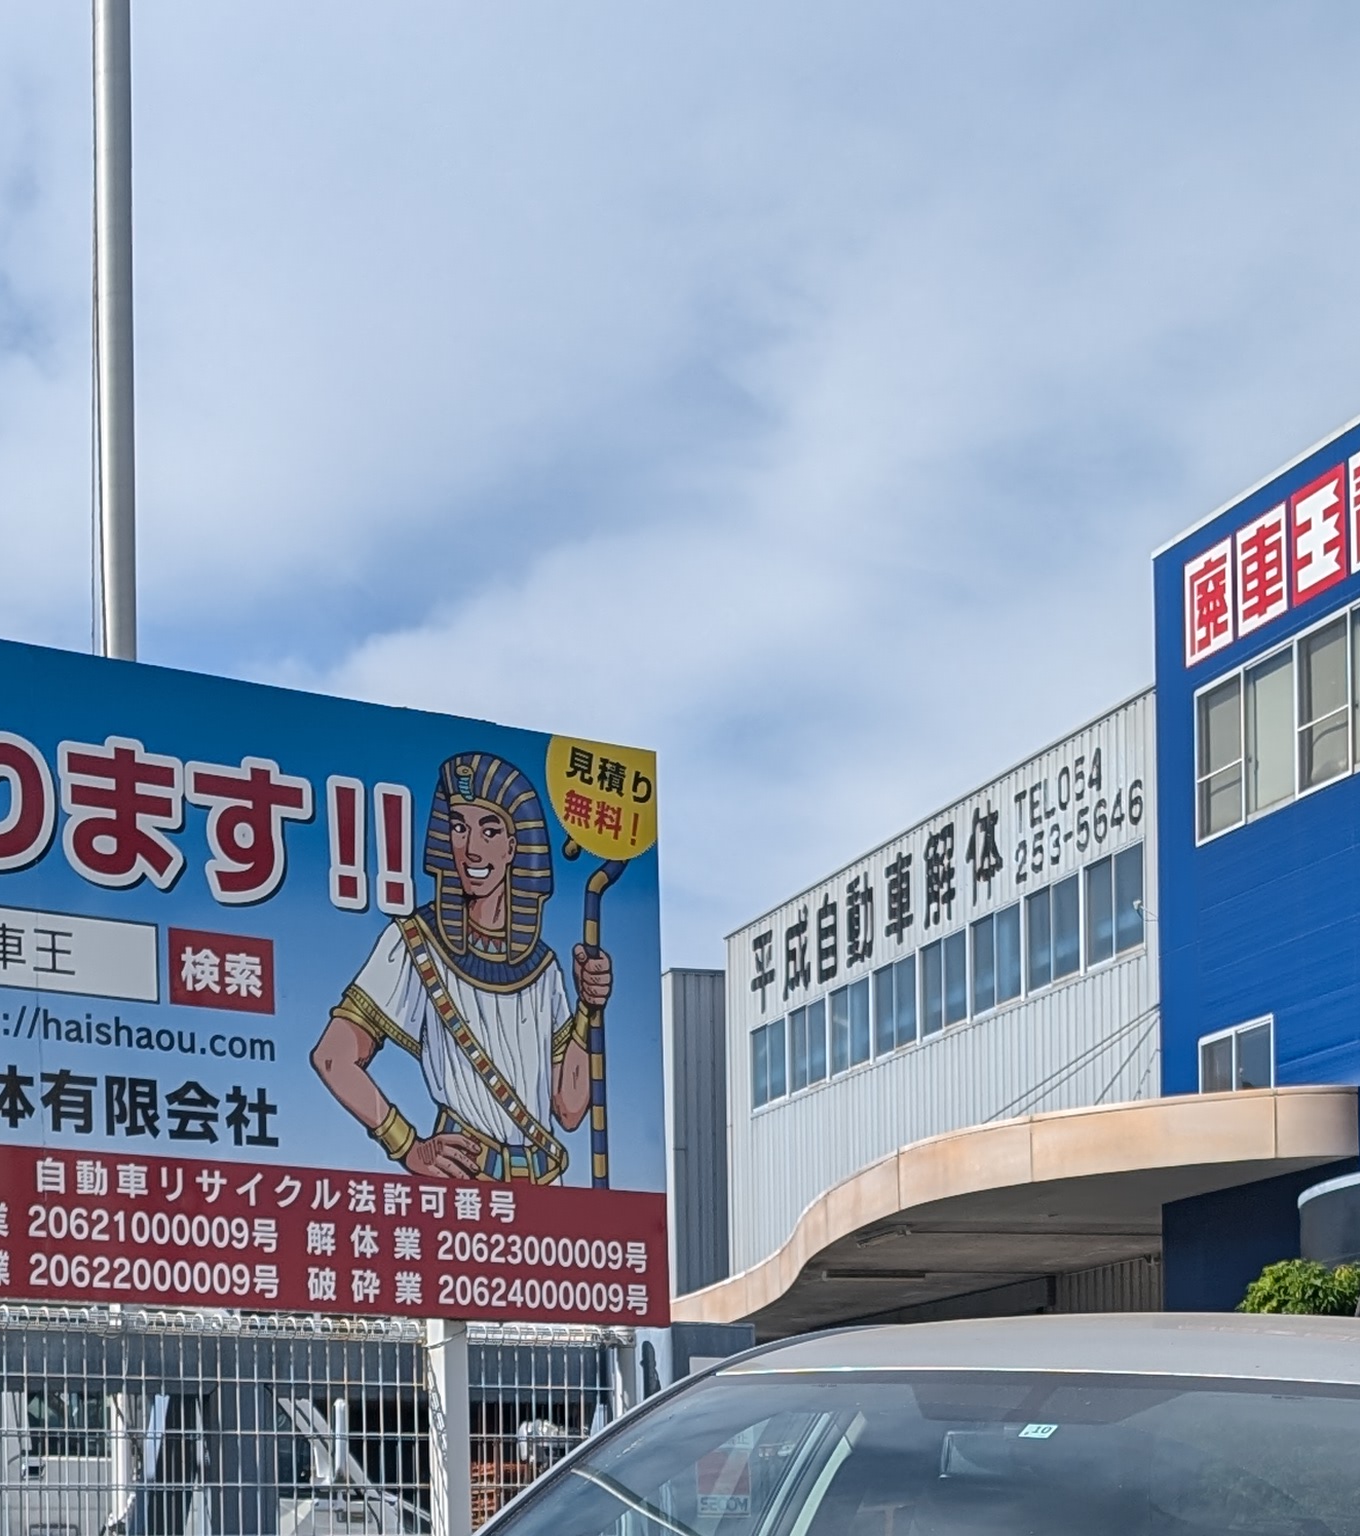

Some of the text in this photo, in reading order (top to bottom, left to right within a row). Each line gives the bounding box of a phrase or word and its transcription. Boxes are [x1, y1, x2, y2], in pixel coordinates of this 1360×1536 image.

[566, 746, 652, 803] 見積り
[563, 789, 639, 846] 無料！
[1015, 778, 1143, 885] 253-5646
[751, 800, 1003, 1013] 平成自動車解体
[180, 946, 263, 999] 検索
[36, 1157, 517, 1224] 自動車リサイクル法許可番号
[28, 1205, 278, 1254] 20621000009号
[306, 1221, 422, 1261] 解体業
[437, 1230, 648, 1274] 20623000009号
[29, 1253, 279, 1300] 20622000009号
[307, 1267, 423, 1305] 破砕業
[438, 1274, 648, 1316] 20624000009号
